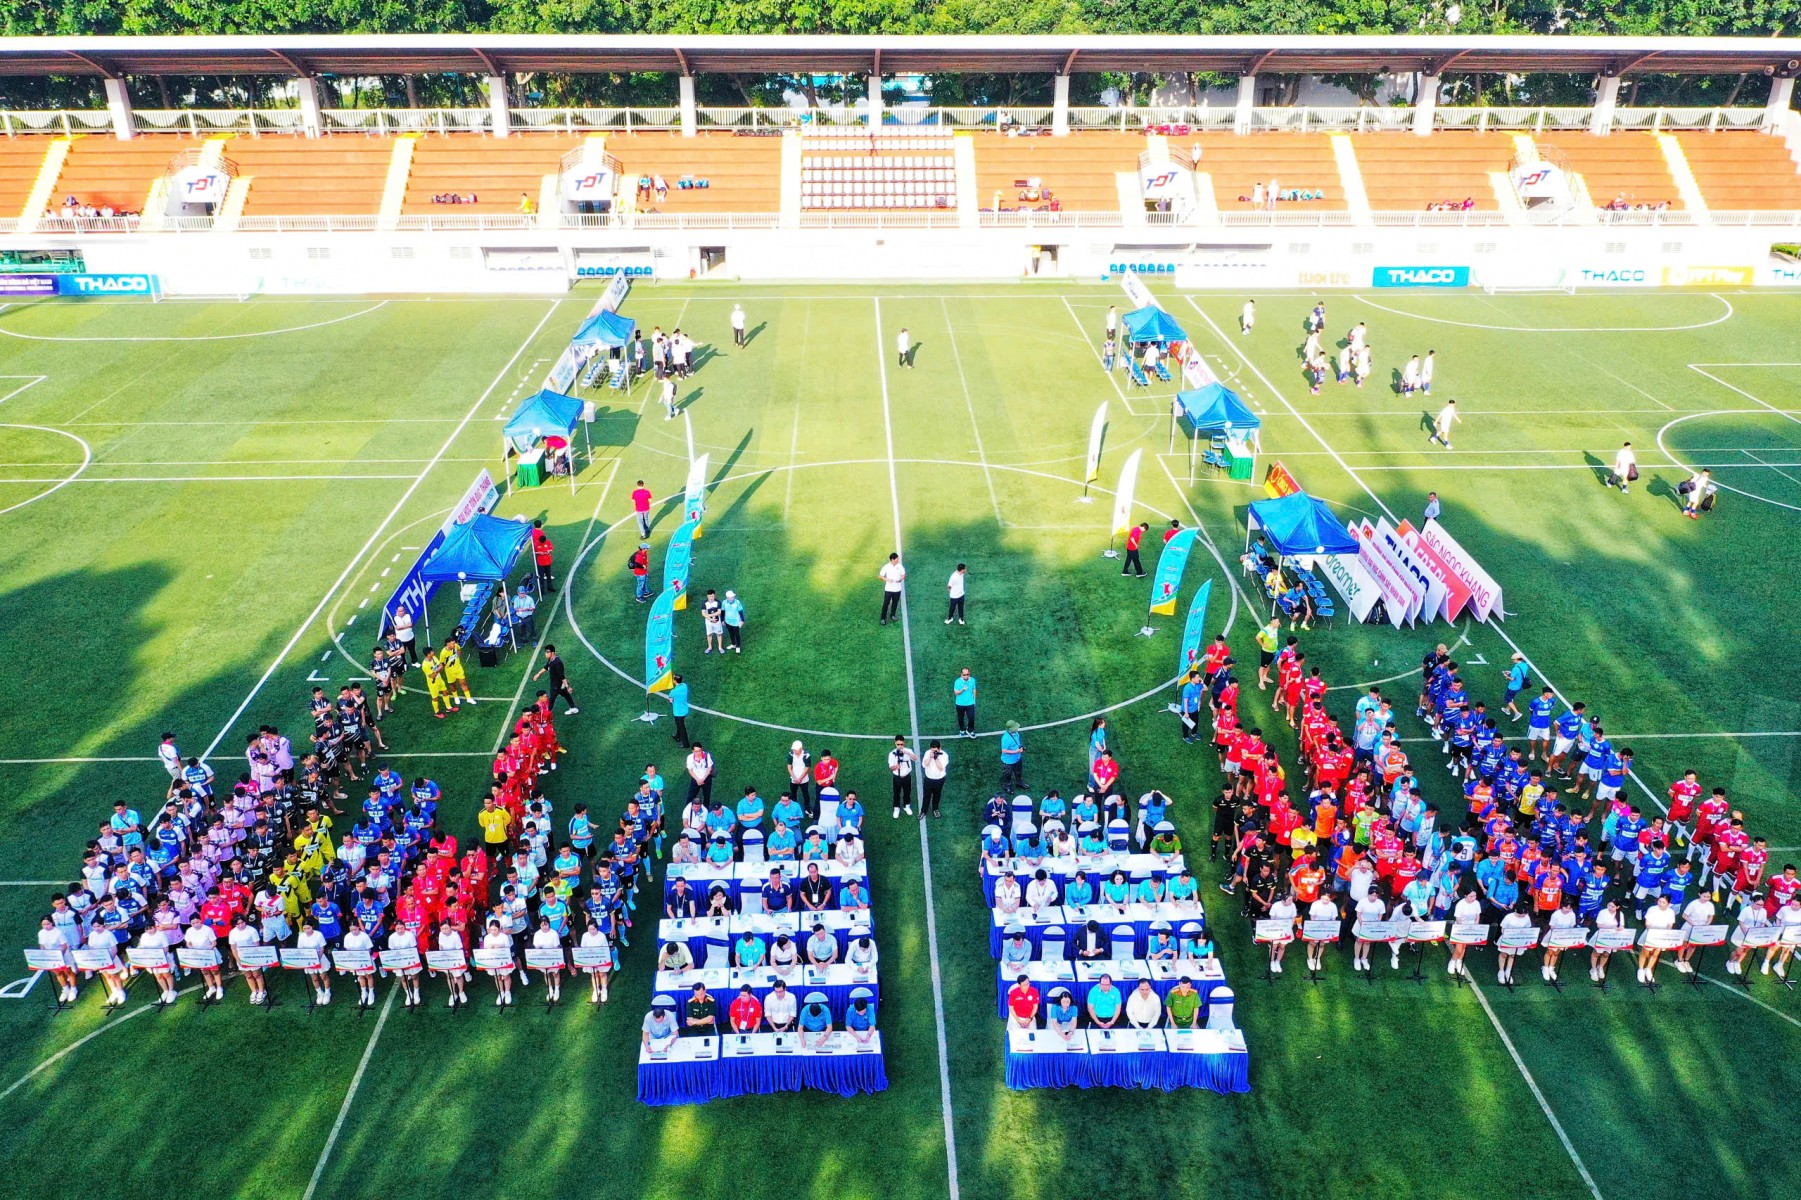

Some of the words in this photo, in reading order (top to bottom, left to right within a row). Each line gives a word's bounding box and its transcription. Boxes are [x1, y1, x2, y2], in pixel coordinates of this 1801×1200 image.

[186, 175, 217, 194] TDT
[575, 172, 607, 191] TDT
[1147, 171, 1178, 190] TDT
[74, 277, 147, 291] THACO
[1387, 269, 1455, 283] THACO
[1581, 269, 1645, 282] THACO
[1459, 567, 1490, 608] KHANG
